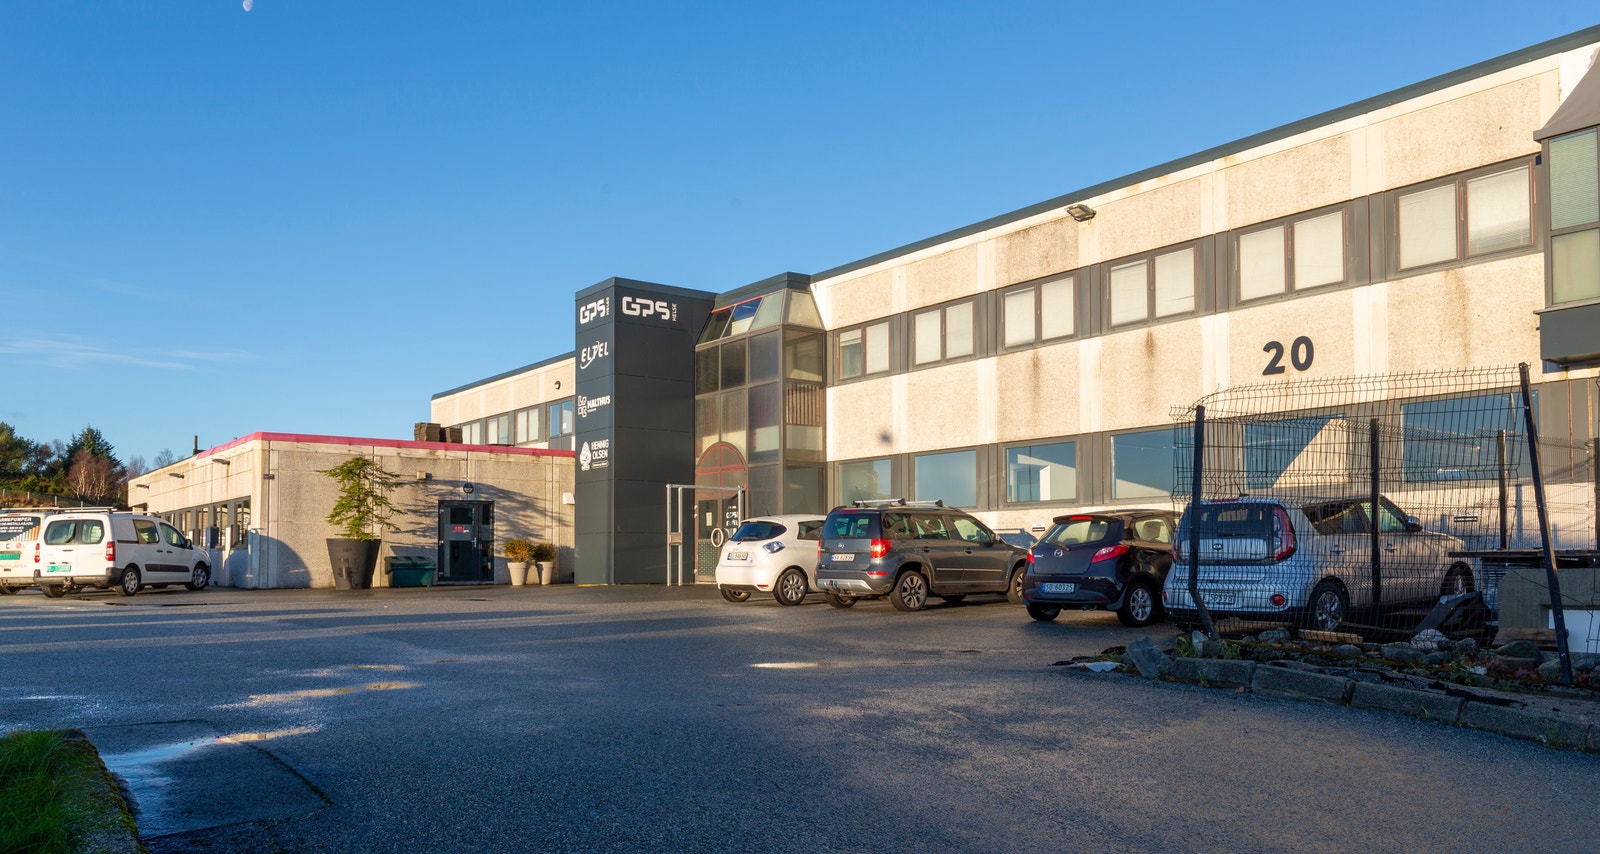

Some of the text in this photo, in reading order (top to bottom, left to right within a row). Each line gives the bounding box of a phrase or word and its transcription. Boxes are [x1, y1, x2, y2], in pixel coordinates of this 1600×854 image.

[580, 299, 606, 324] GPS
[622, 296, 670, 320] GPS
[1262, 335, 1314, 376] 20
[587, 395, 611, 409] MALTHUS
[591, 439, 609, 450] HENNIG
[592, 449, 609, 460] OLSEN
[1055, 583, 1073, 591] 60325
